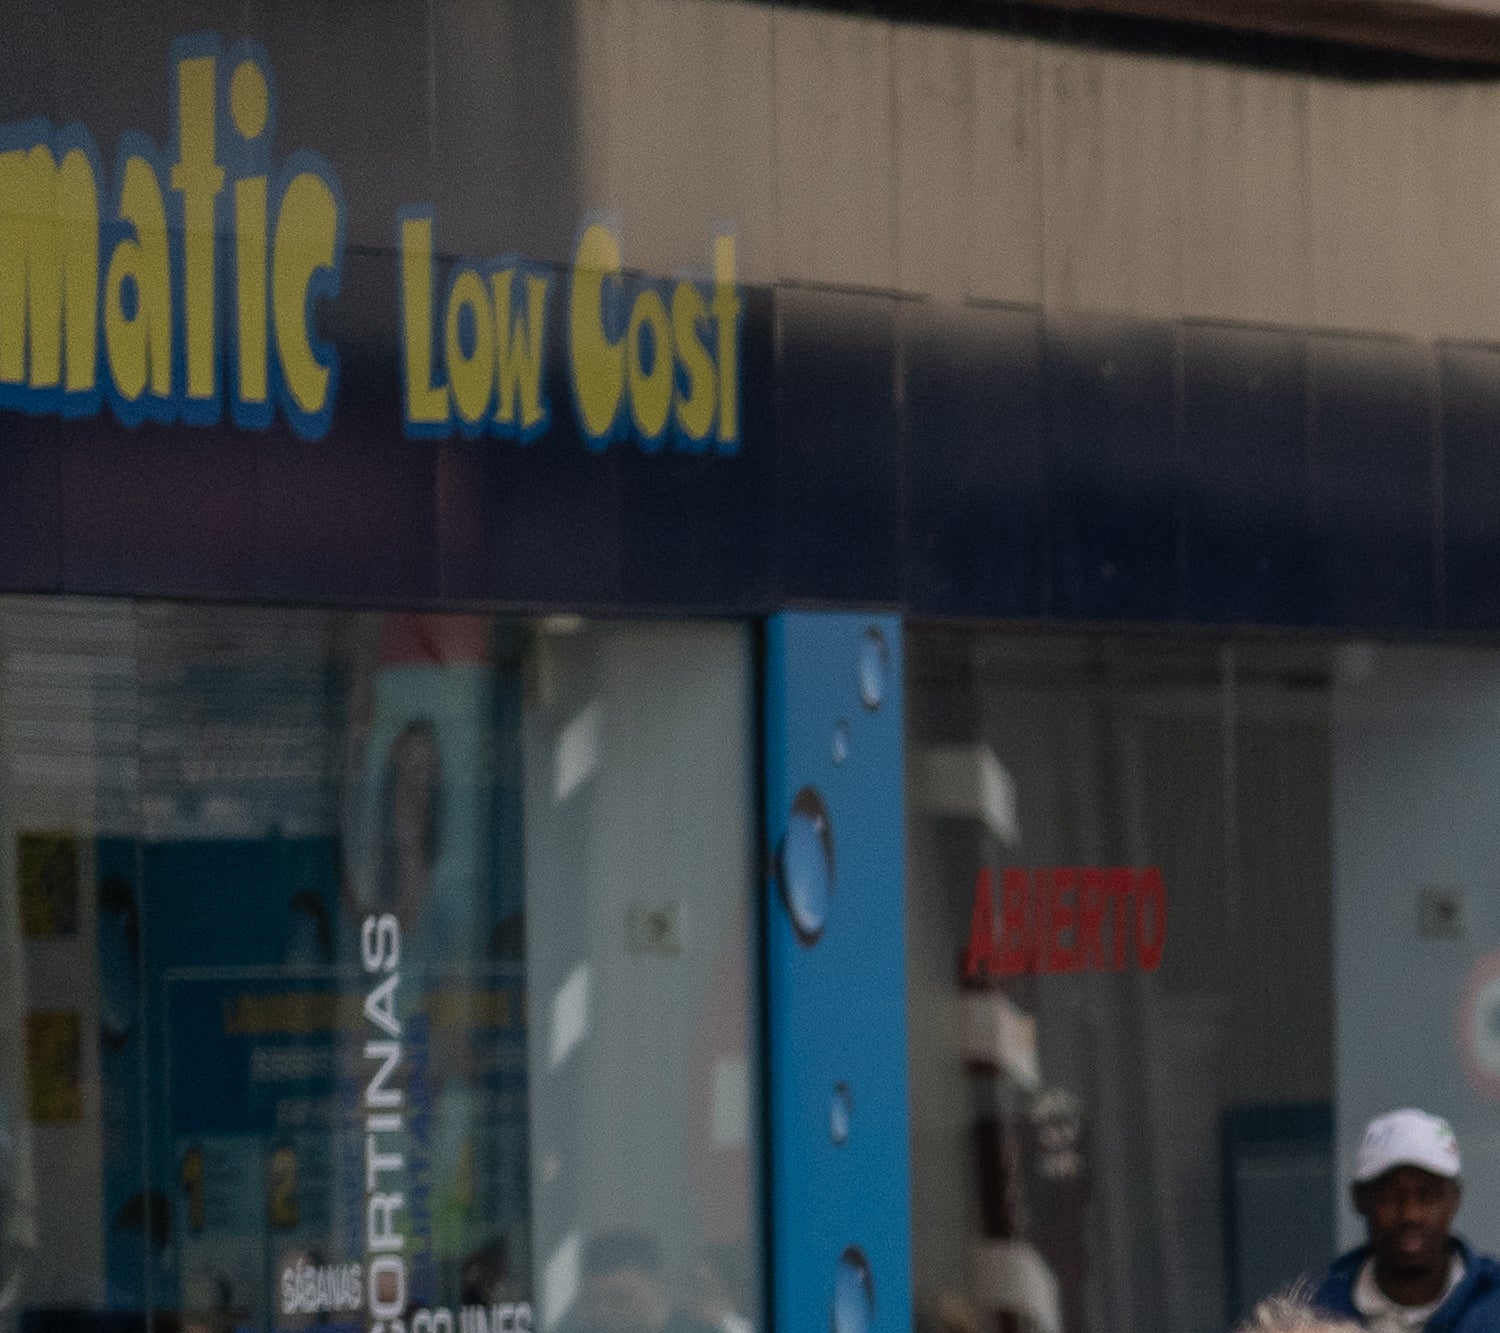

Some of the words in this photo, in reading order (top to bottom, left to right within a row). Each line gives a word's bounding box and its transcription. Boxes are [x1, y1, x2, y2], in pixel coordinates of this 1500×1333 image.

[398, 208, 550, 441] Low
[568, 212, 742, 452] Cost
[965, 866, 1168, 978] ABIERTO
